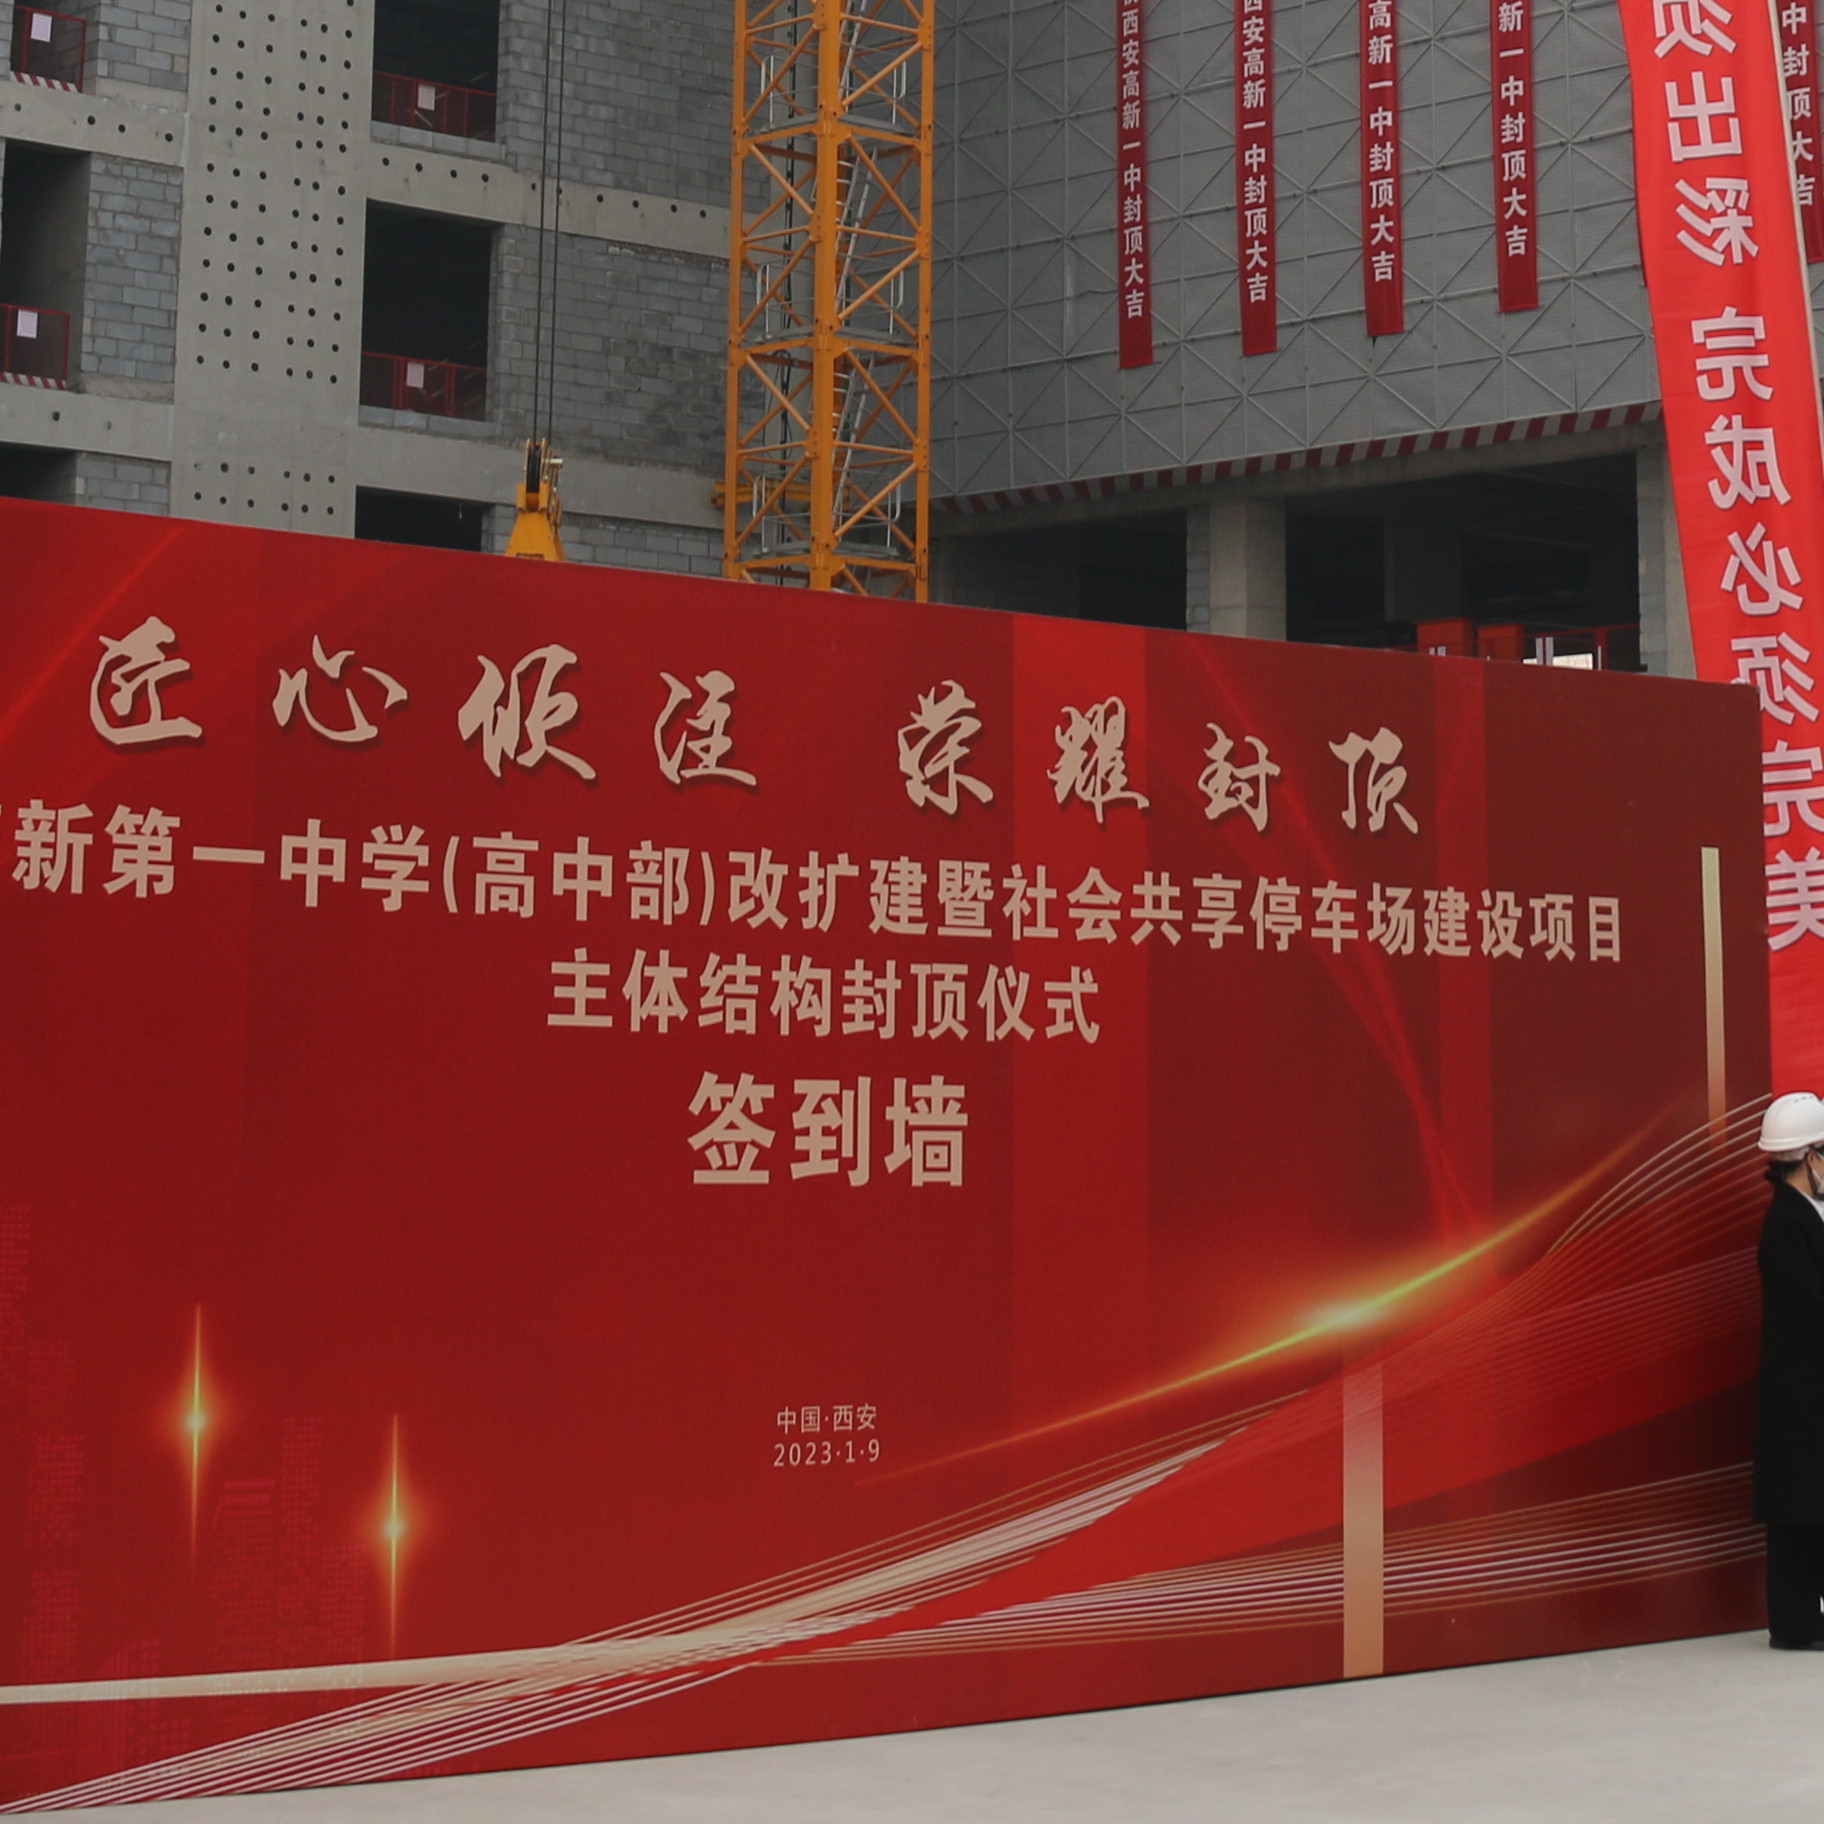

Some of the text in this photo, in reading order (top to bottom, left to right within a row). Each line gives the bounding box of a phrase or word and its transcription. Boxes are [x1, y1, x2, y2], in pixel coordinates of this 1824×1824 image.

[896, 679, 1420, 835] 荣耀封顶
[547, 947, 1101, 1044] 主体结构封顶仪式
[687, 1070, 968, 1187] 签到墙
[776, 1402, 877, 1435] 中国·西安
